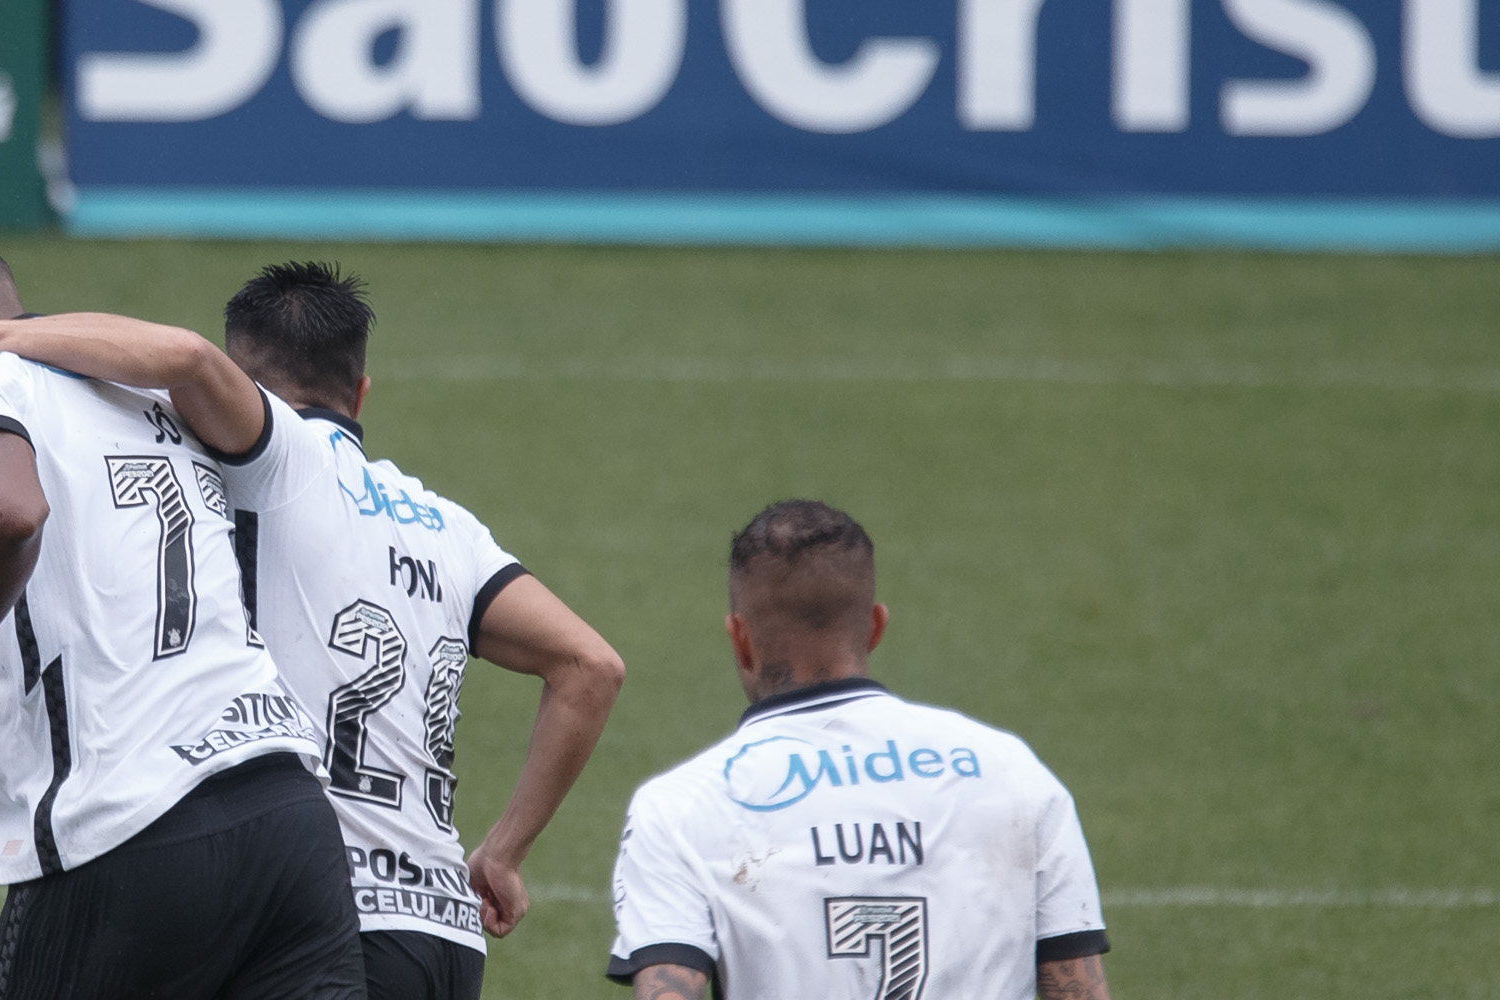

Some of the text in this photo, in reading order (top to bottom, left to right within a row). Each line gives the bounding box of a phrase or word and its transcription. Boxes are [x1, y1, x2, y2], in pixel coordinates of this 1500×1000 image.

[142, 401, 183, 445] JÔ
[722, 735, 982, 812] Midea
[810, 821, 925, 866] LUAN
[355, 888, 483, 935] CELULARES
